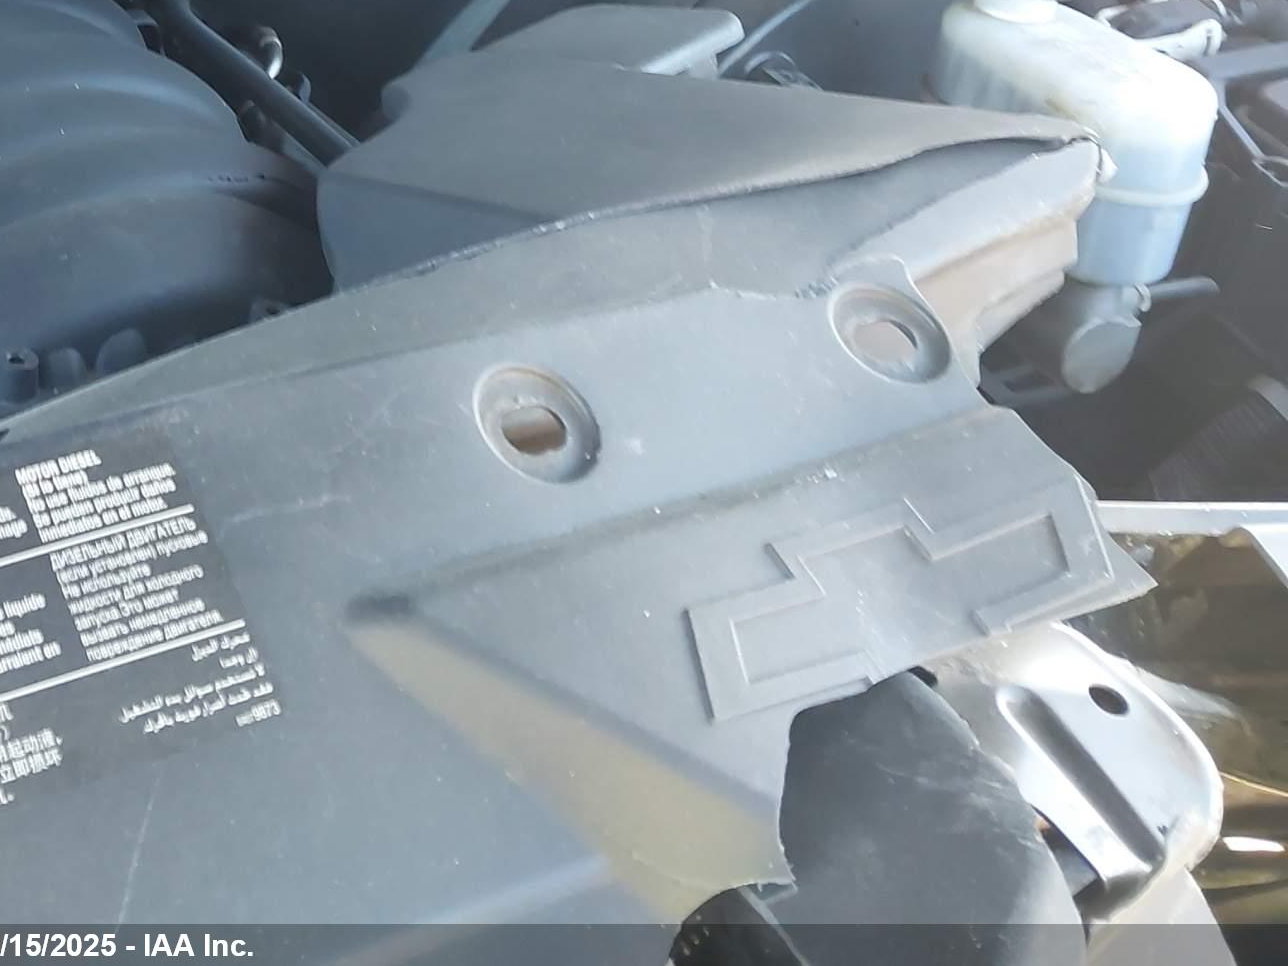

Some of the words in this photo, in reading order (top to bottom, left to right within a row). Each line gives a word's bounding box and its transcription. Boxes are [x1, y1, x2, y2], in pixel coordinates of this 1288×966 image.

[14, 460, 59, 485] MOTOR
[57, 449, 101, 472] DIESEL
[26, 498, 45, 514] No
[45, 492, 67, 508] use
[106, 475, 122, 491] de
[102, 510, 118, 524] en
[118, 504, 130, 519] el
[50, 534, 125, 571] ДИЗЕЛЬНЫЙ
[126, 517, 196, 548] ДВИГАТЕЛЬ
[123, 582, 144, 599] для
[3, 593, 45, 617] liquide
[43, 641, 61, 658] en
